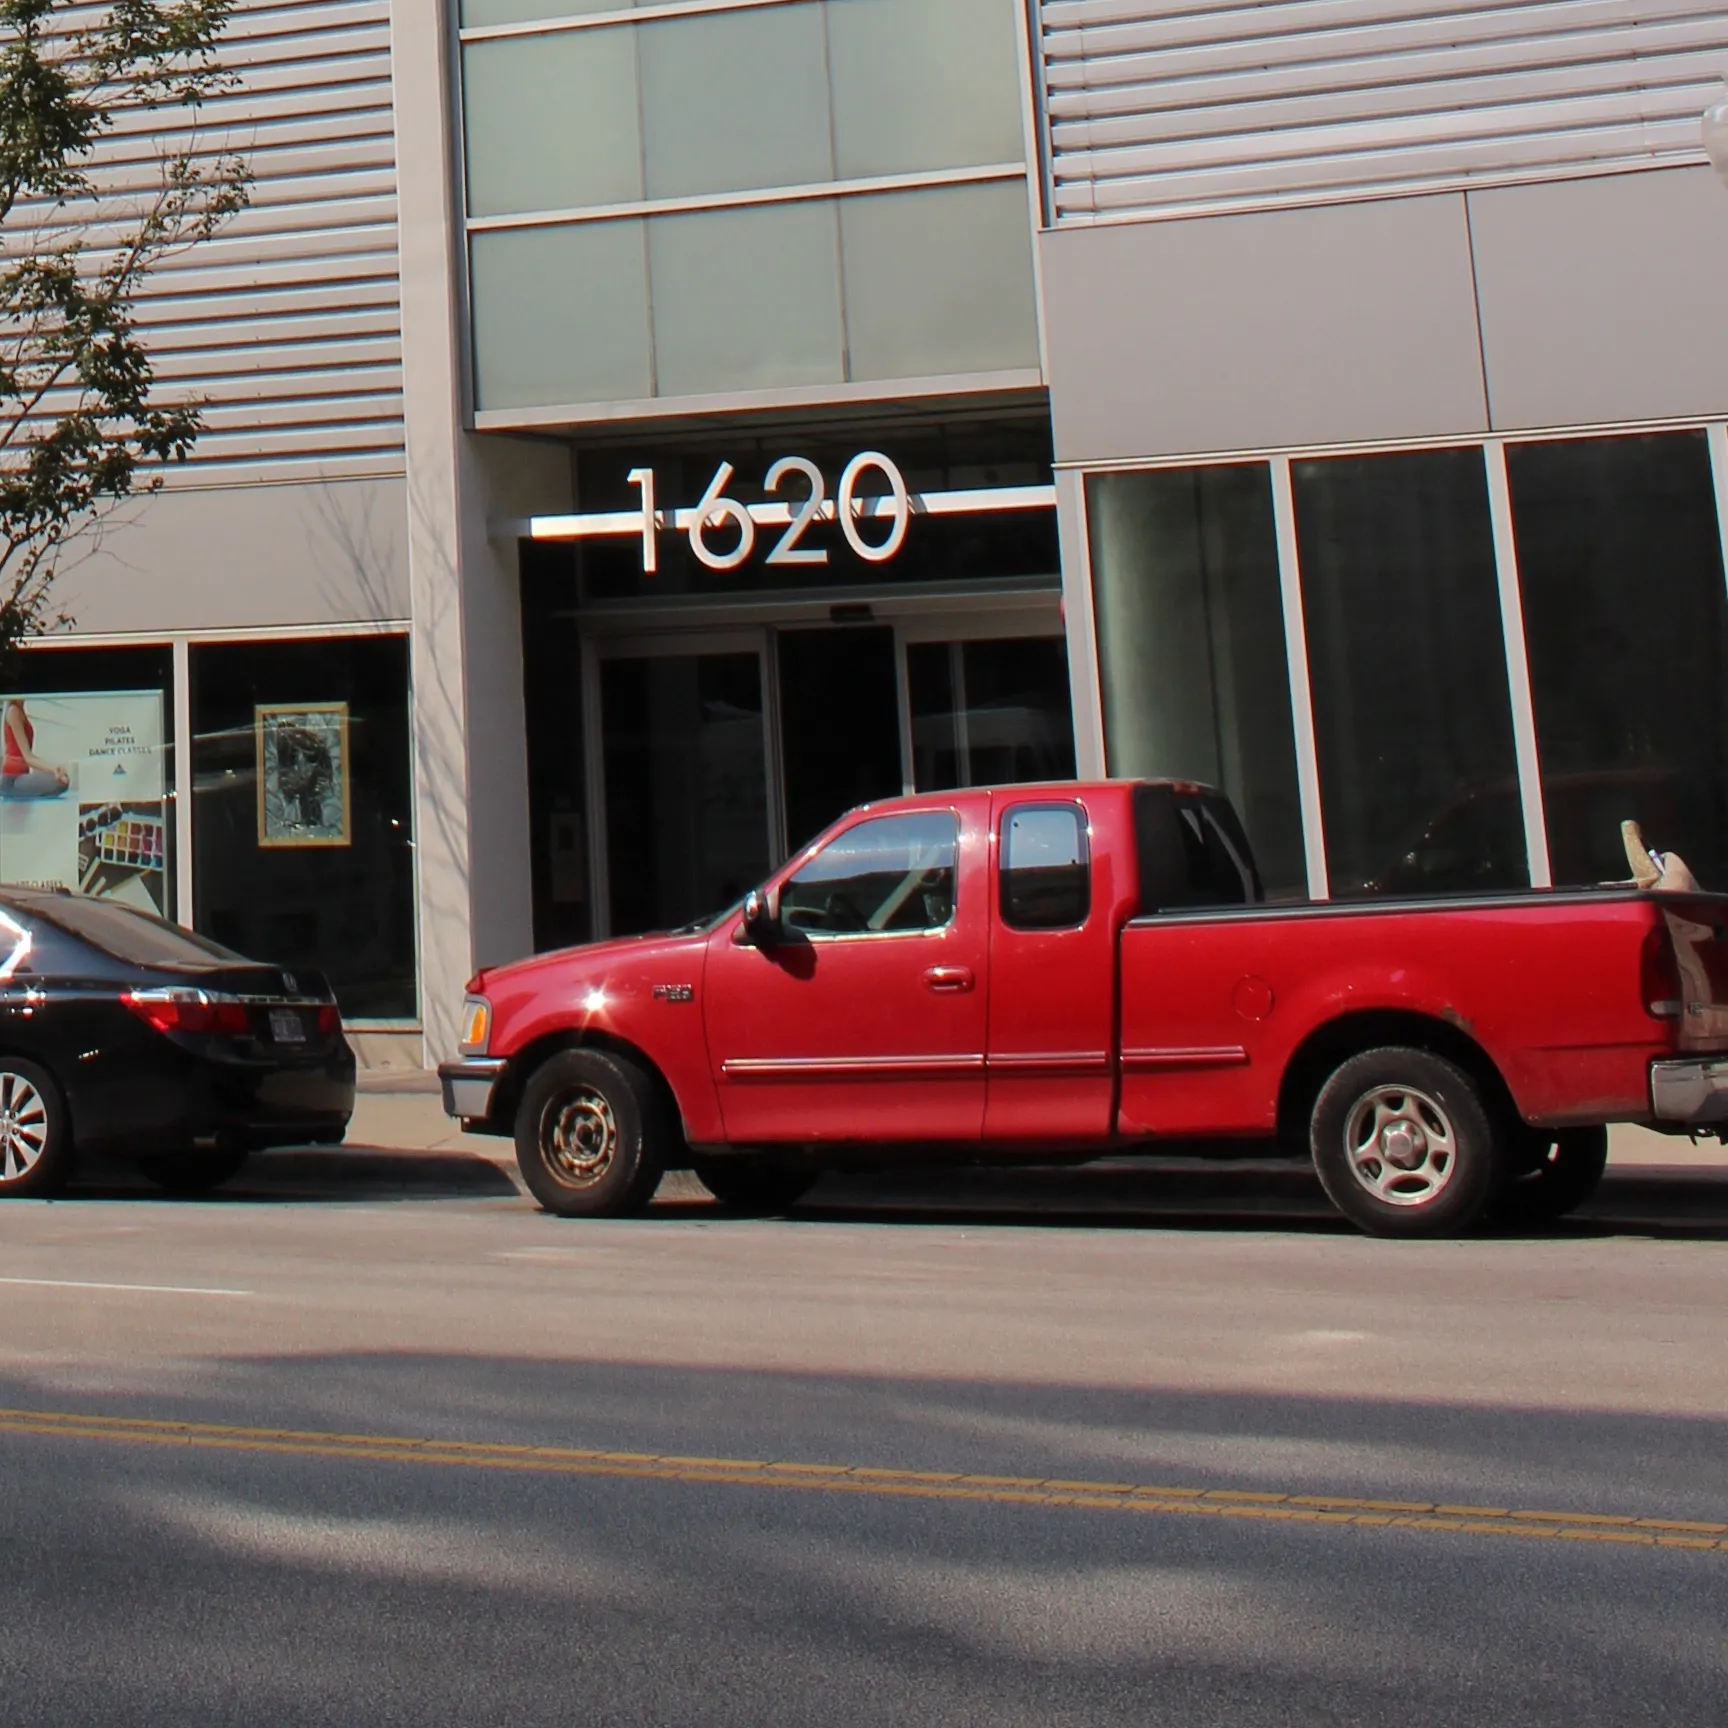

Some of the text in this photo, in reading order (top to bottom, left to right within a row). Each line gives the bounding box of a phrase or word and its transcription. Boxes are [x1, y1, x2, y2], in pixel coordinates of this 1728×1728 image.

[627, 450, 909, 573] 1620
[109, 726, 131, 735] YOGA
[105, 736, 135, 745] PILATES
[89, 747, 115, 756] DANCE
